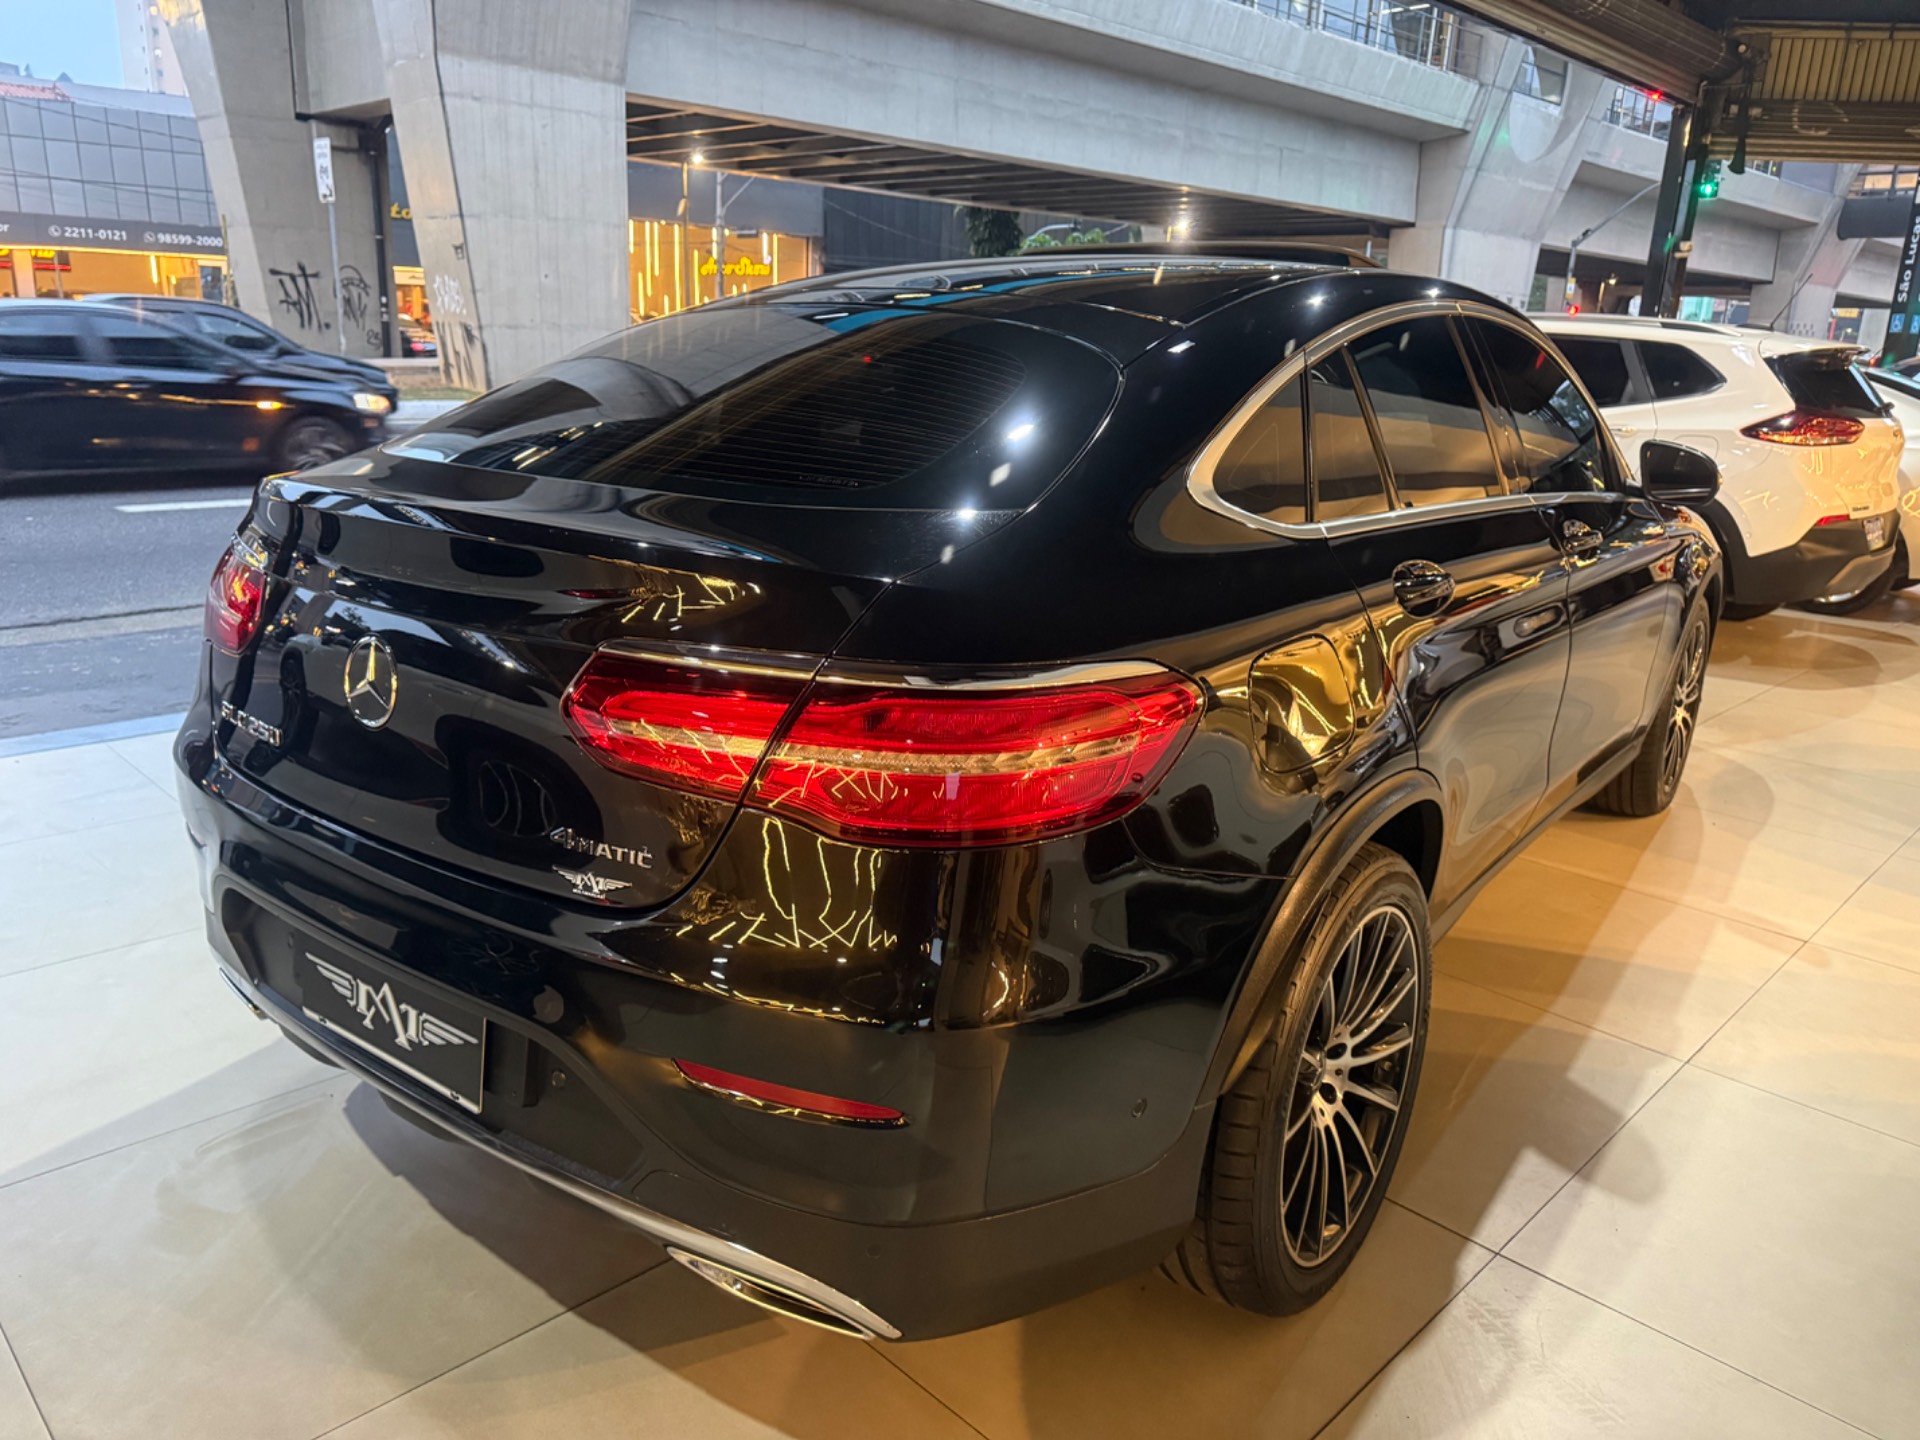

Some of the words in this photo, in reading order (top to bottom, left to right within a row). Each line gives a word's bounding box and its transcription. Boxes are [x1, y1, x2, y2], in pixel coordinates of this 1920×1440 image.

[64, 226, 128, 241] 2211-0121
[157, 232, 223, 247] 98599-2000
[550, 826, 653, 869] 4MATIC
